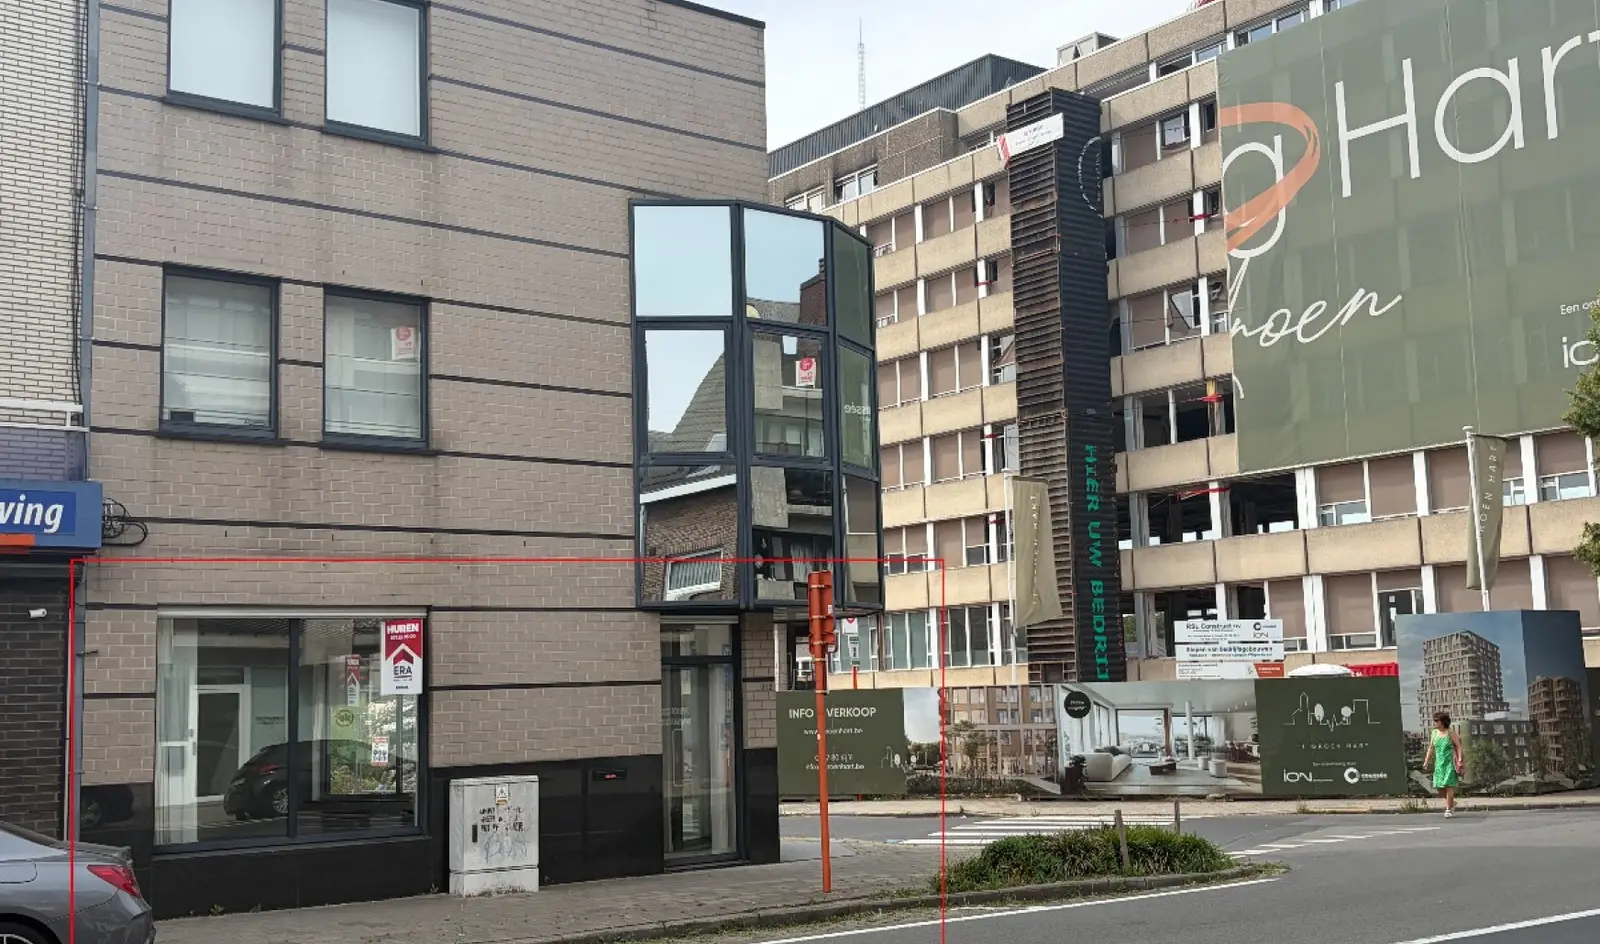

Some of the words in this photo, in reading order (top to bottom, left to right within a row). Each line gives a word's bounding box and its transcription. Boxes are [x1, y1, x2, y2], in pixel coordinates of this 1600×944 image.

[1560, 304, 1580, 315] Een
[1085, 444, 1100, 512] HIER
[1088, 521, 1102, 569] UW
[387, 622, 420, 634] HUREN
[394, 666, 413, 675] ERA
[788, 708, 815, 719] INFO
[826, 706, 877, 718] VERKOOP
